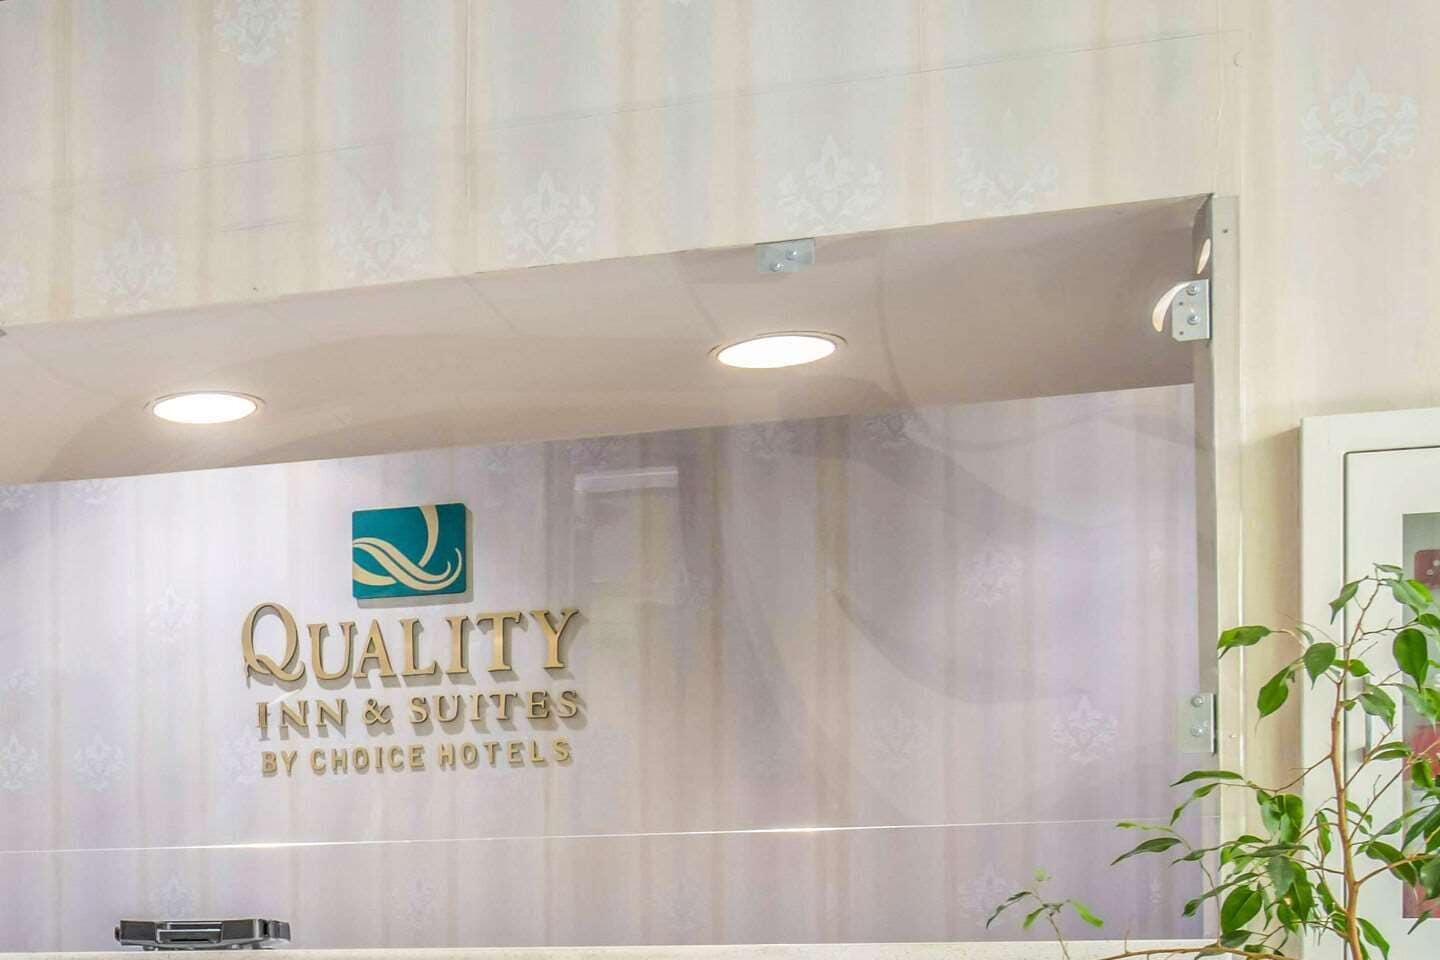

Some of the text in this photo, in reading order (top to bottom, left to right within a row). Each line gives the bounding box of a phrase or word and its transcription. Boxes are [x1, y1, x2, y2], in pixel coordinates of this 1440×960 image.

[241, 602, 580, 682] QUALITY
[256, 690, 580, 728] INN & SUITES
[262, 739, 571, 776] BY CHOICE HOTELS
